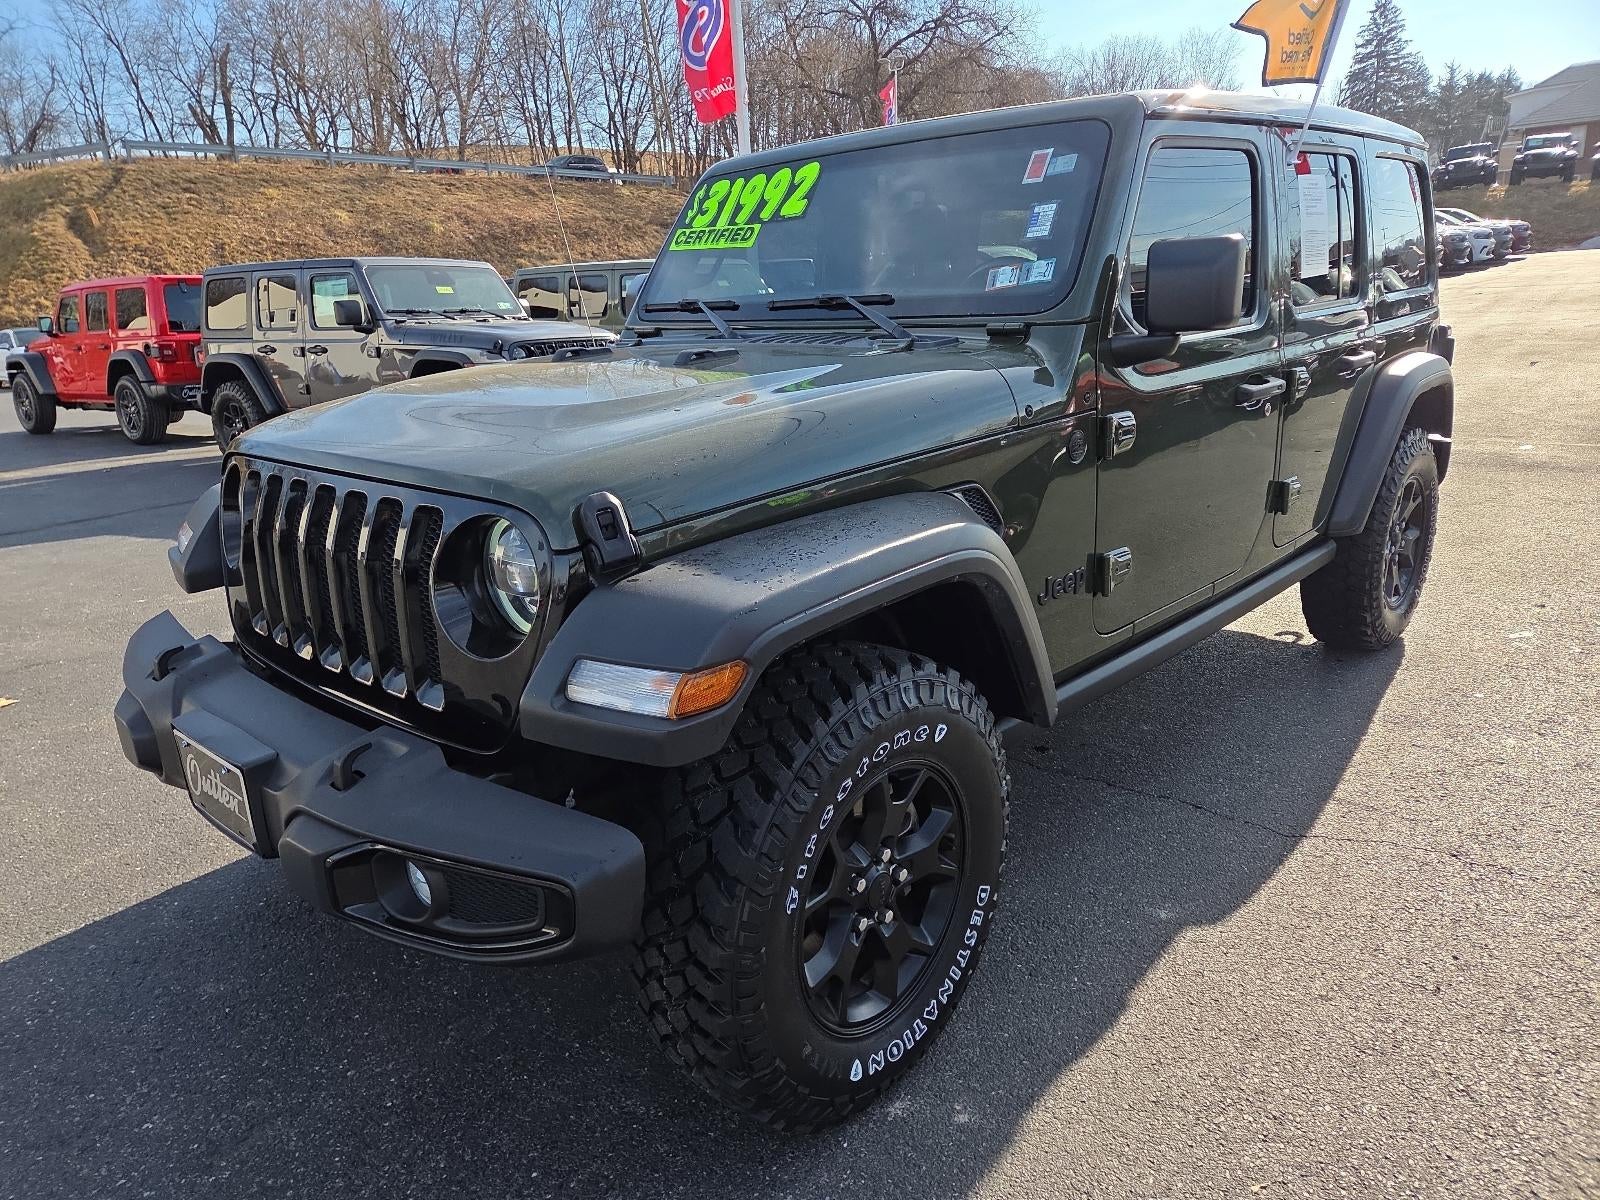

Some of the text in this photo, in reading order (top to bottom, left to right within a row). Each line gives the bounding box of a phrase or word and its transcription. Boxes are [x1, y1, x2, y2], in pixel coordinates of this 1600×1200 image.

[685, 161, 821, 229] $31992
[674, 227, 756, 248] CERTIFIED
[1038, 566, 1086, 606] Jeep
[786, 724, 930, 915] Firestone
[867, 885, 991, 1076] DESTINATION
